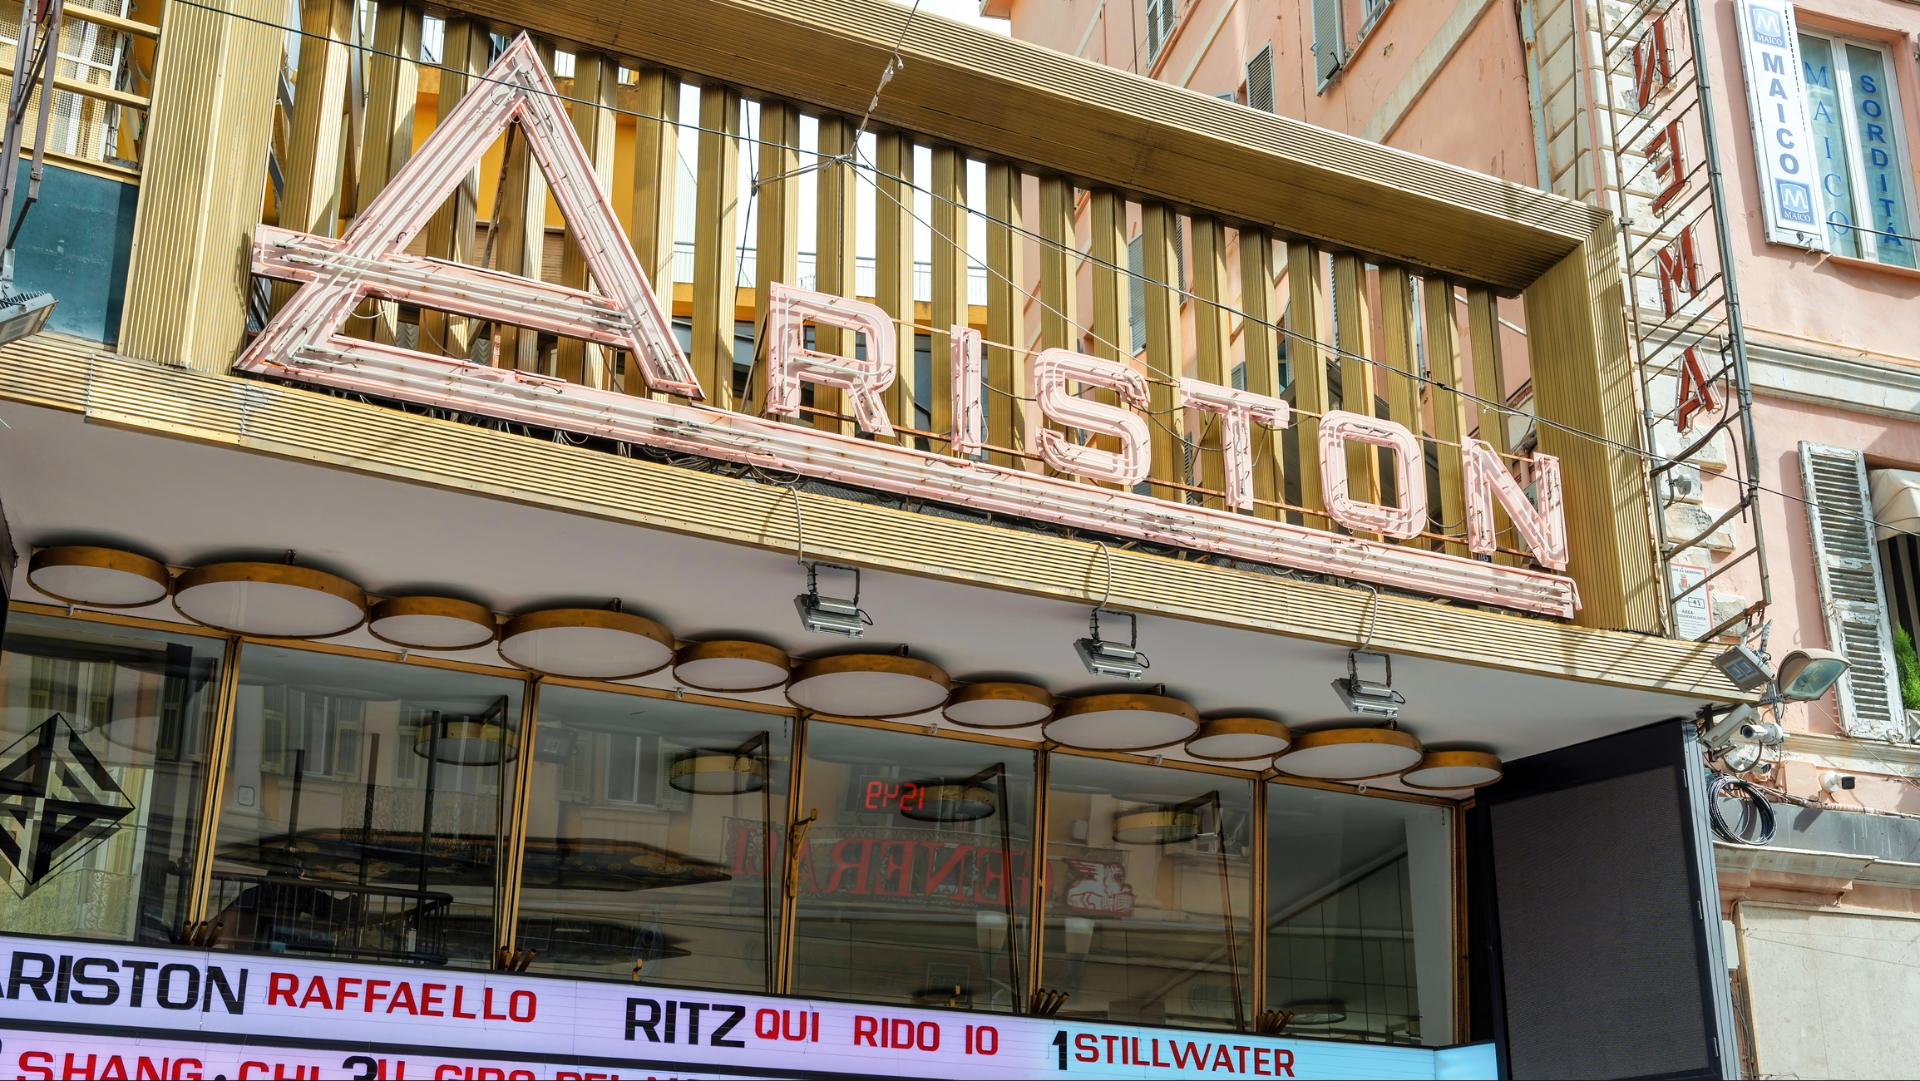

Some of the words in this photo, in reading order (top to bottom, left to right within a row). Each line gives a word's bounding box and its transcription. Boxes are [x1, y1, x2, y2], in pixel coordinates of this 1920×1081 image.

[1757, 33, 1783, 46] MAICO
[1762, 51, 1800, 175] MAICO
[1804, 62, 1851, 236] MAICO
[1784, 209, 1811, 223] MAICO
[233, 31, 1567, 574] ARISTON
[0, 951, 249, 1015] RISTON
[269, 973, 537, 1023] RAFFAELLO
[625, 997, 746, 1048] RITZ
[755, 1009, 819, 1042] QUI
[854, 1015, 940, 1052] RIDO
[965, 1025, 998, 1056] IO
[1052, 1030, 1067, 1070] 1
[1075, 1034, 1295, 1077] STILLWATER
